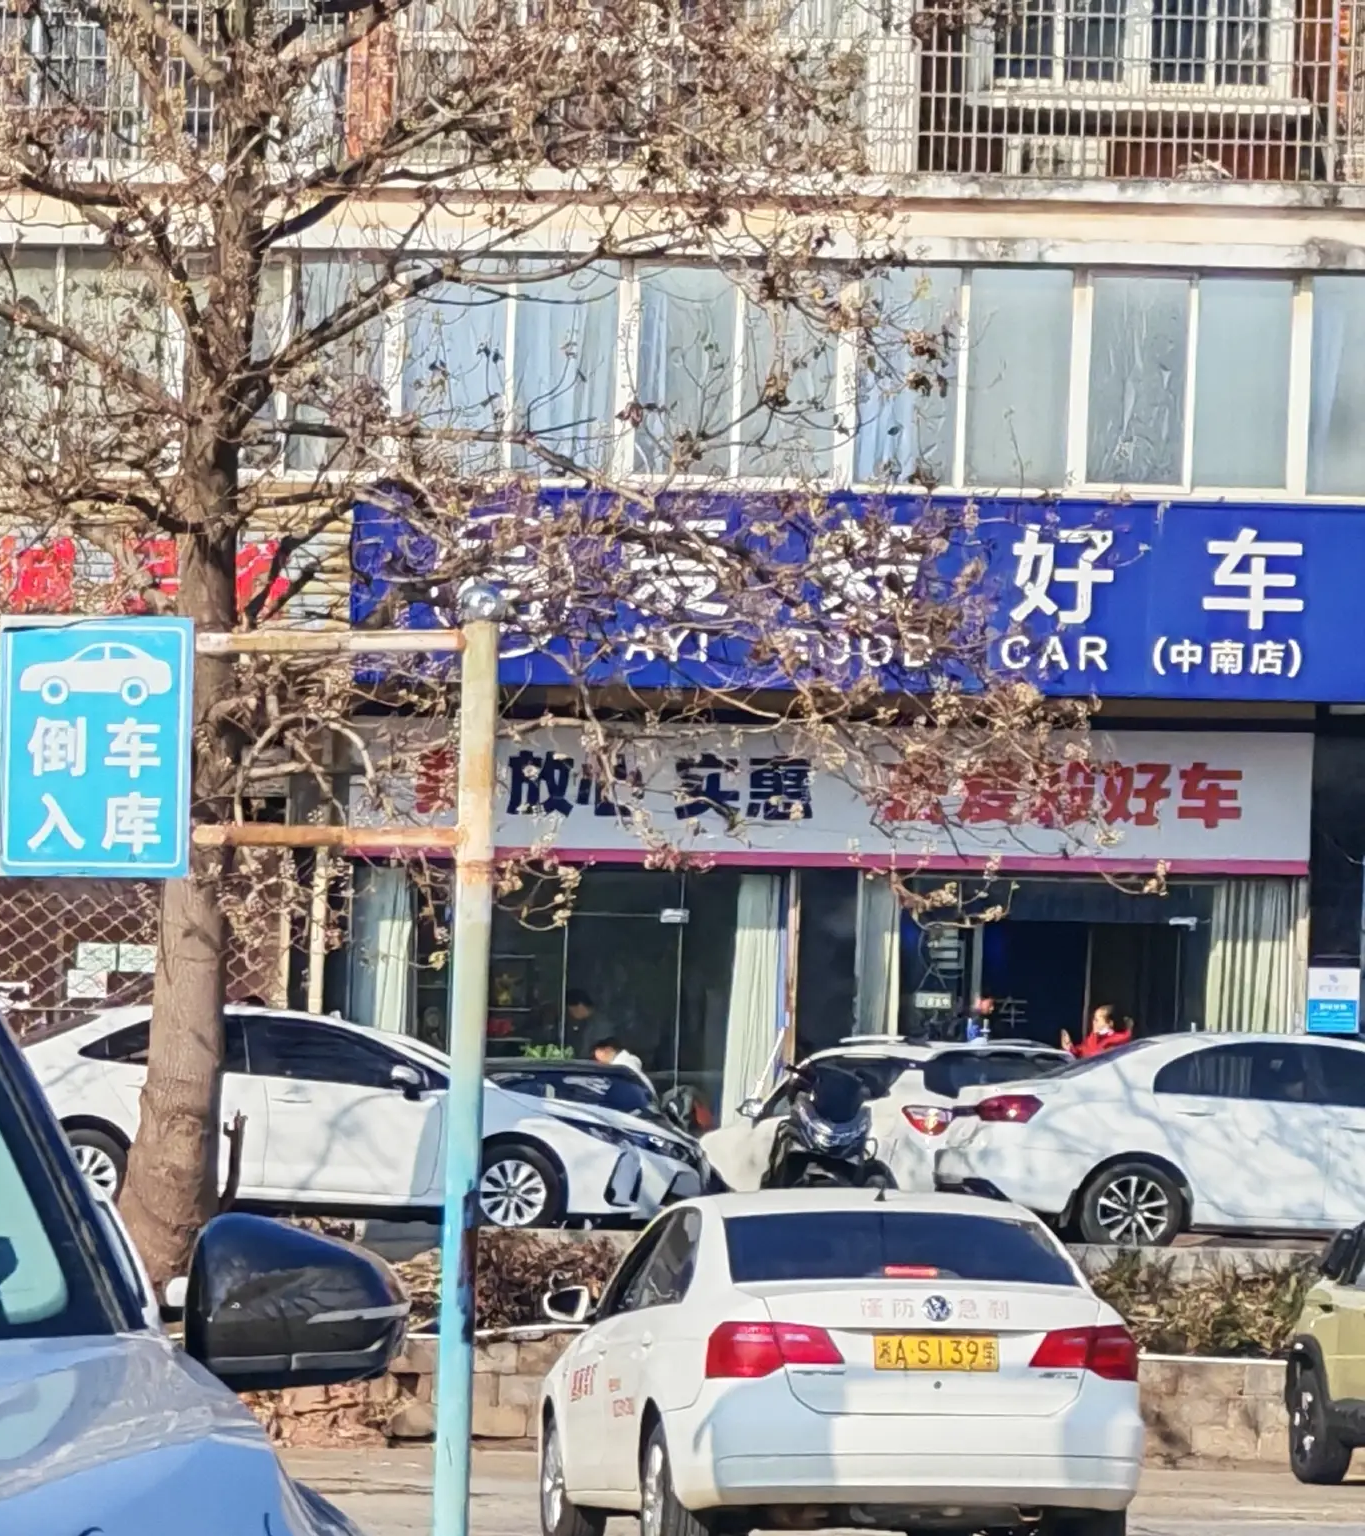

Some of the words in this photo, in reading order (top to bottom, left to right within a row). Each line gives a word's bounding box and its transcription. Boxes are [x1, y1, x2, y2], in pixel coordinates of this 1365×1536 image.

[1001, 637, 1109, 671] CAR
[27, 716, 162, 779] 倒车
[675, 752, 813, 821] 实惠
[26, 792, 162, 855] 入库
